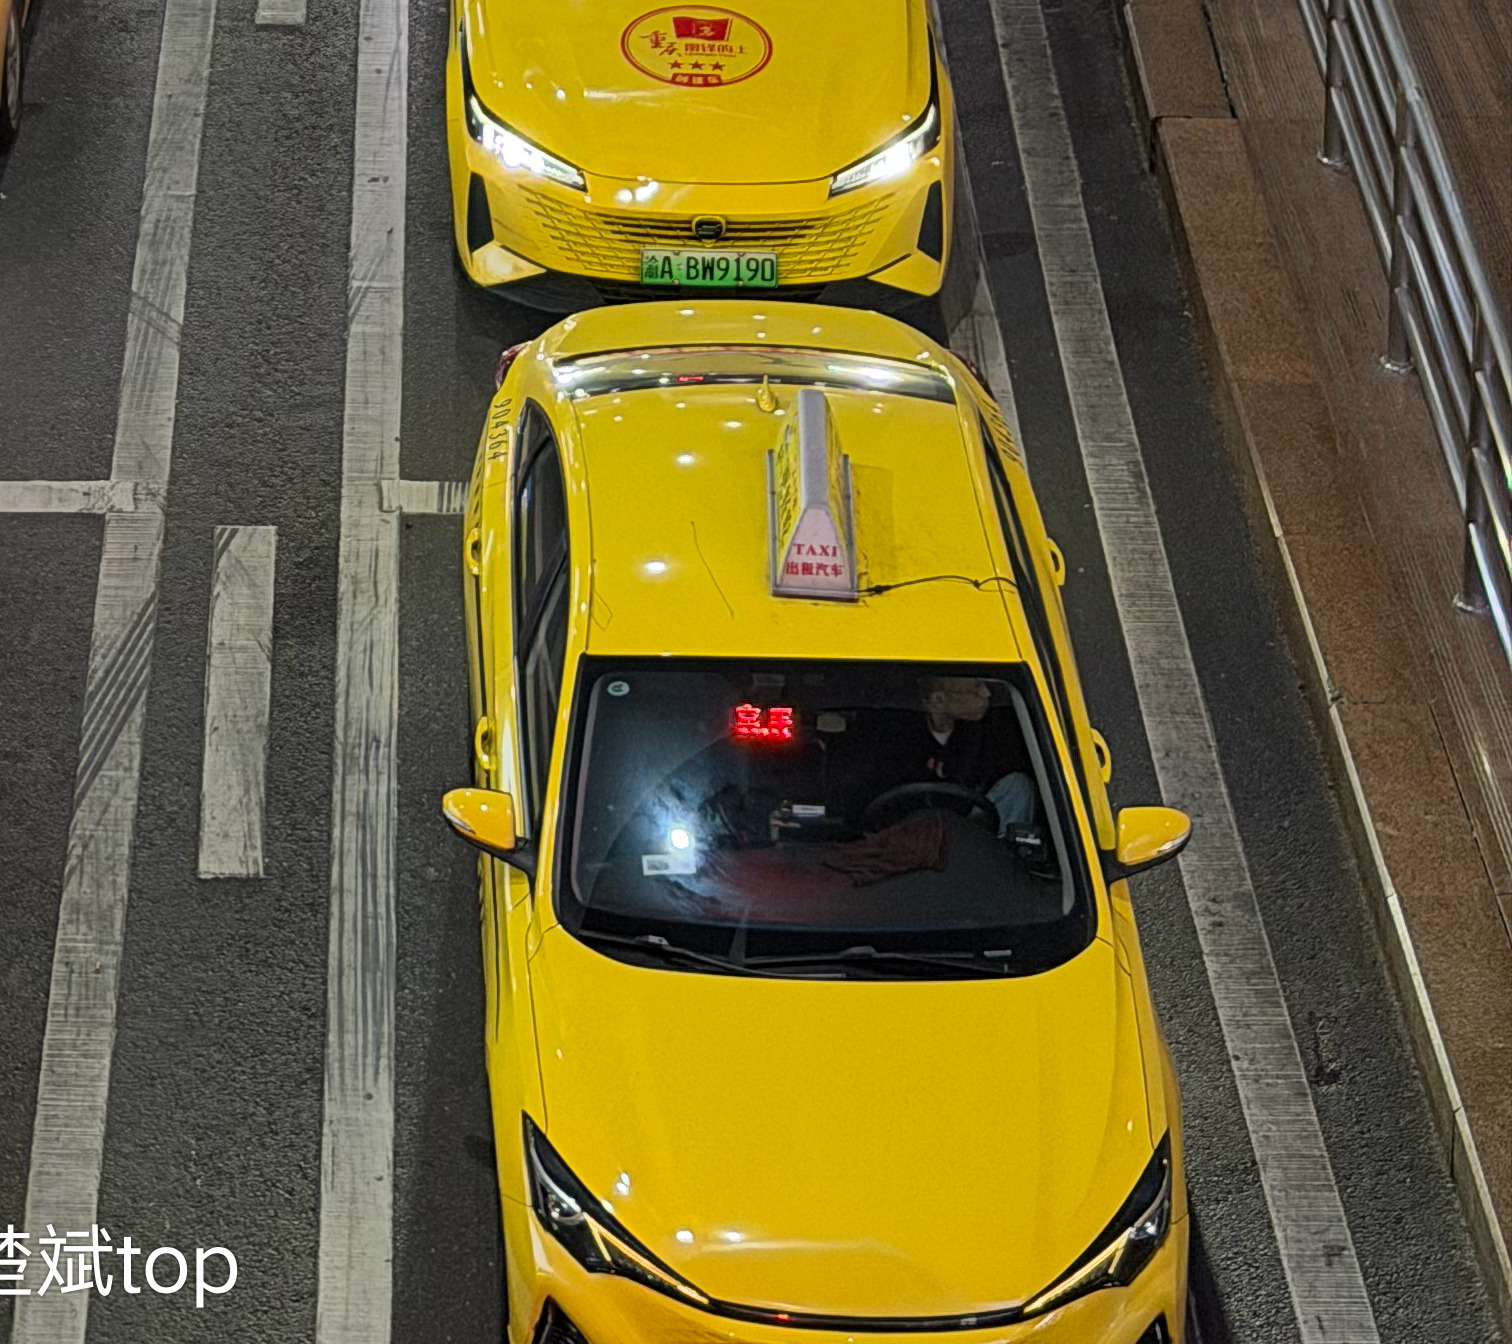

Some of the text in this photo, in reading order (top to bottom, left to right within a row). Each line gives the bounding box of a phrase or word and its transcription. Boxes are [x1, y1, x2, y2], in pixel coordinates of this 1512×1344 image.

[685, 255, 775, 282] BW9190
[791, 543, 838, 558] TAXI
[785, 562, 844, 578] 出租汽车
